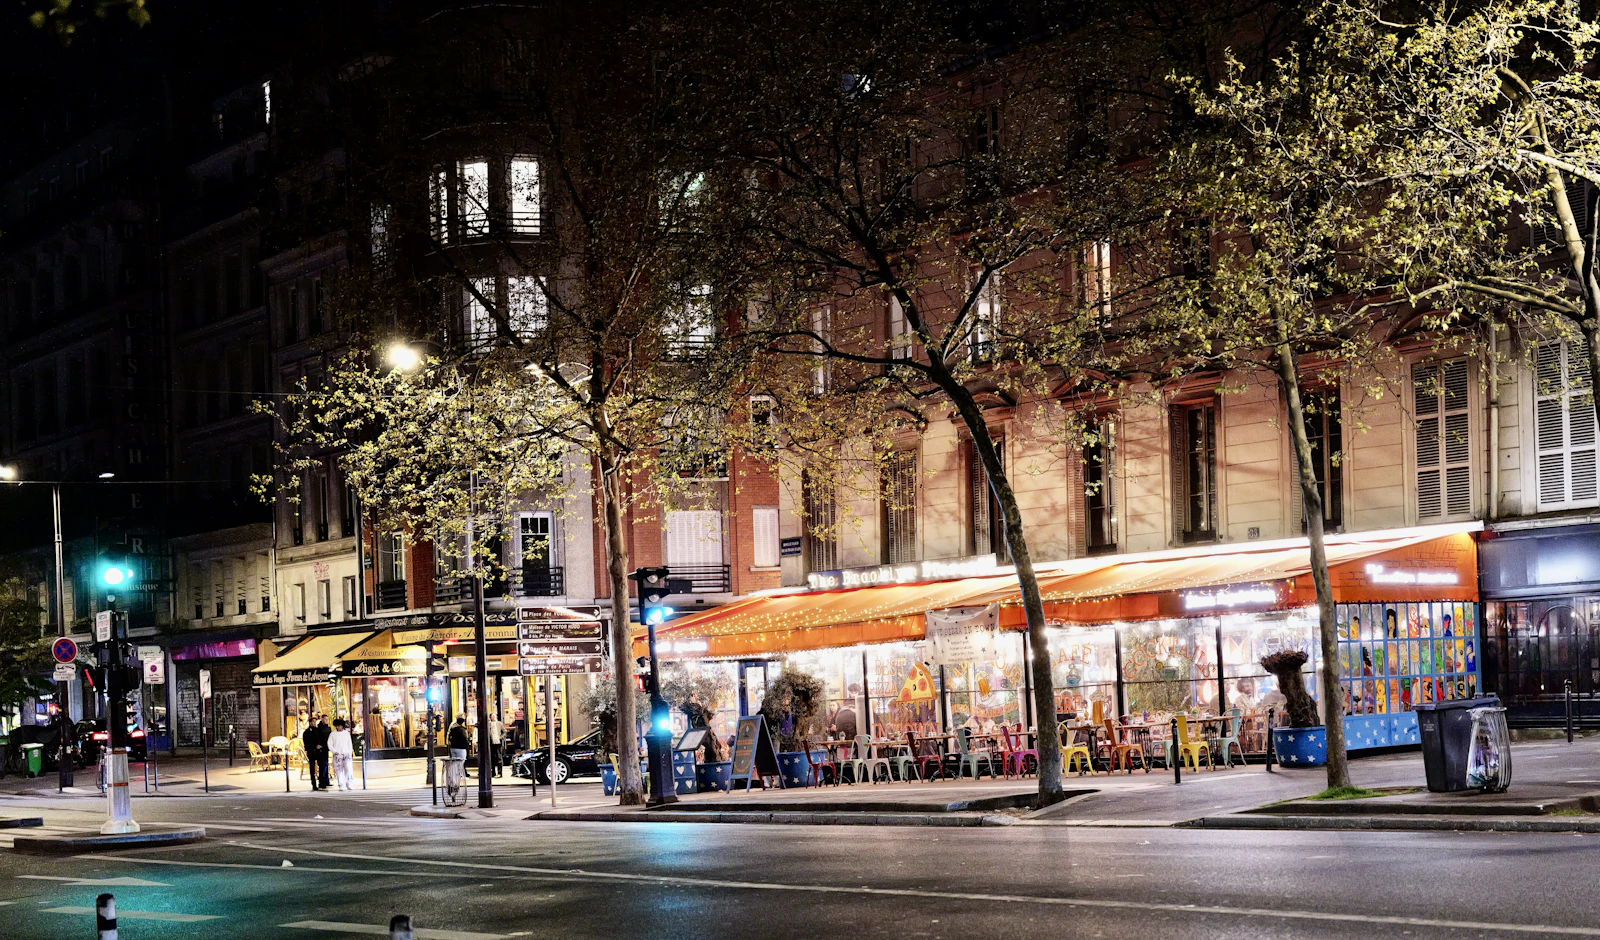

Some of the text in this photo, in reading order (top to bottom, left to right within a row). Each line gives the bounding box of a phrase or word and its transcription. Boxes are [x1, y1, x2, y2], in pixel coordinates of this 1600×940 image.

[808, 574, 835, 588] The
[433, 613, 506, 625] Voses
[1124, 636, 1216, 679] COCKTAILS
[382, 664, 390, 673] &
[875, 658, 906, 677] BEST
